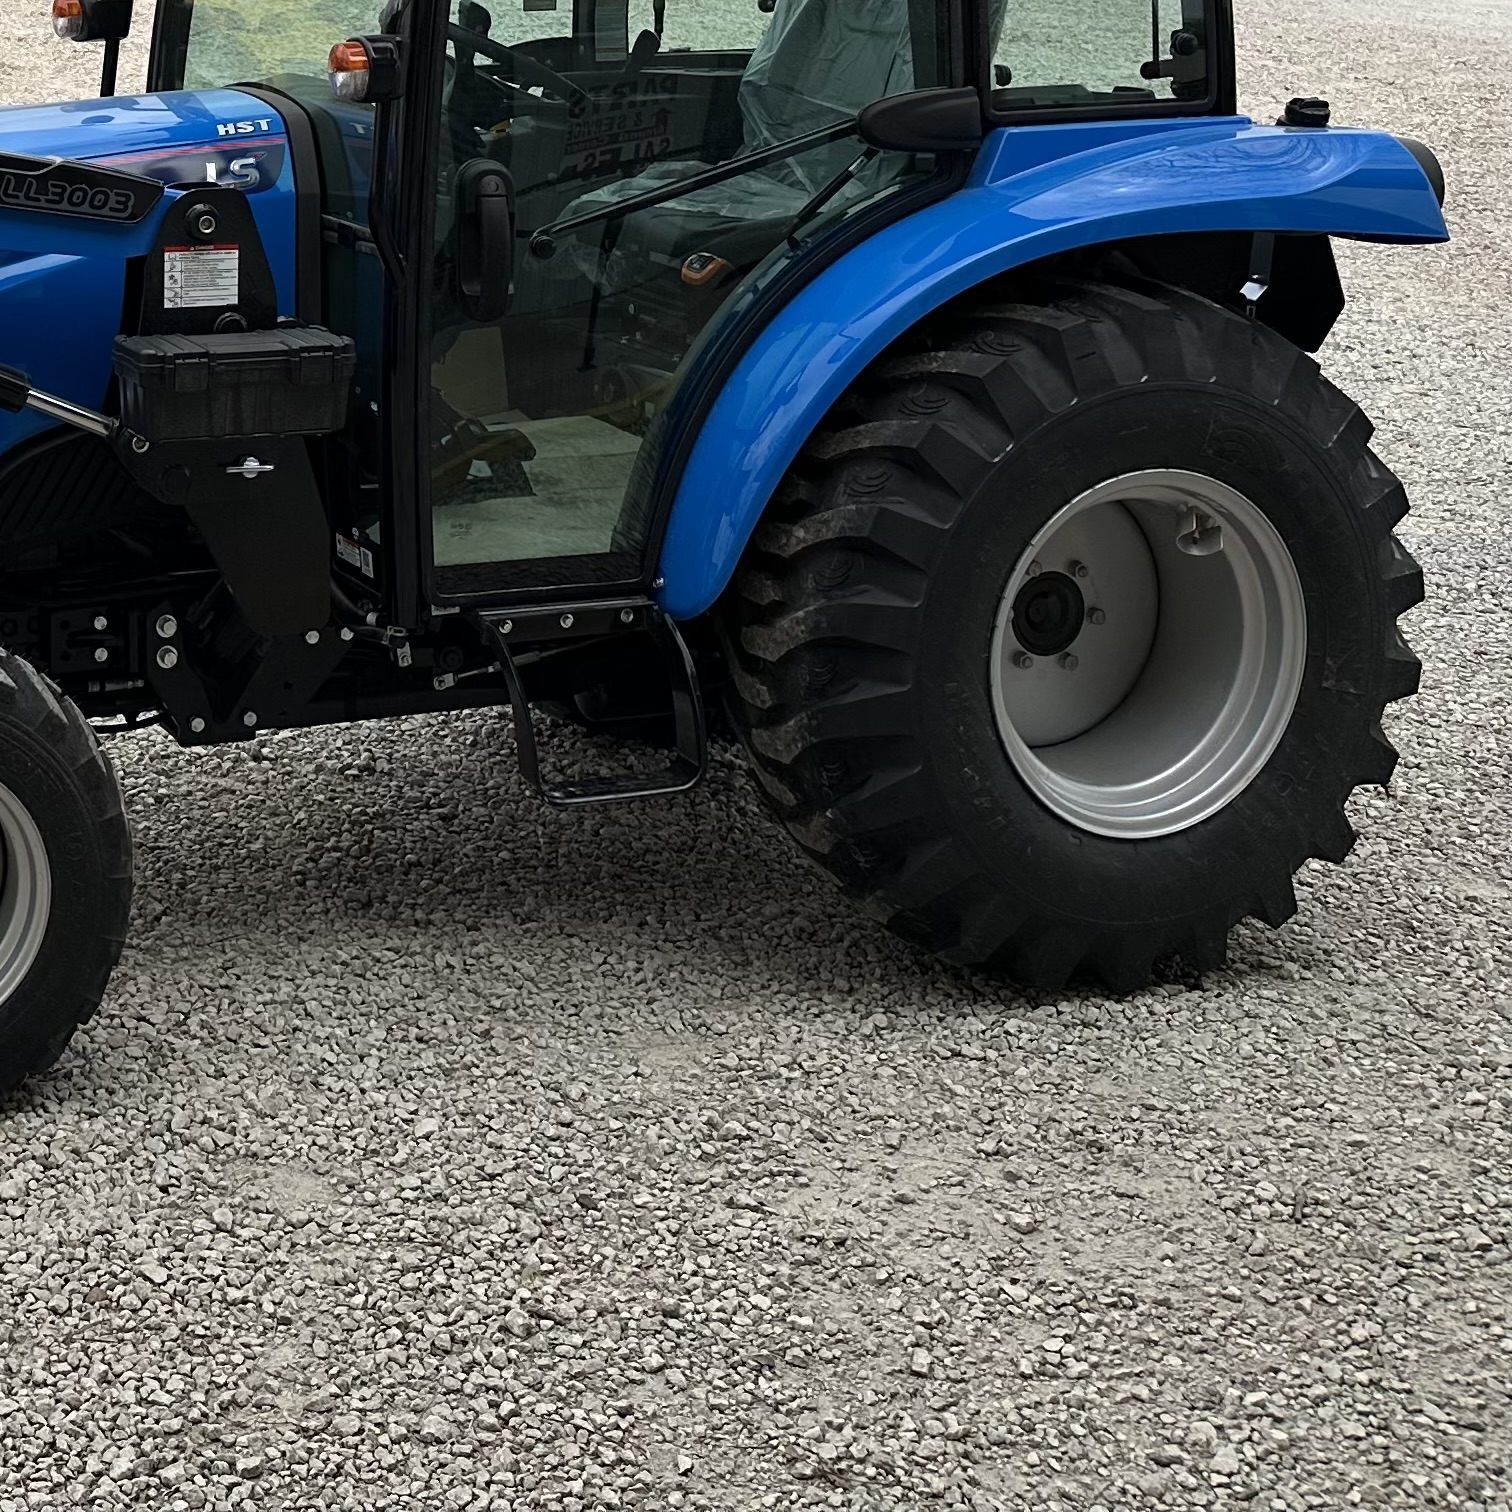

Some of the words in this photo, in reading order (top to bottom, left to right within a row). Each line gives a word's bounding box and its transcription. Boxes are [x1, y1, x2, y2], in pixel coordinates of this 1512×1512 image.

[216, 118, 273, 136] HST
[205, 156, 261, 188] LS
[0, 174, 136, 218] LL3003
